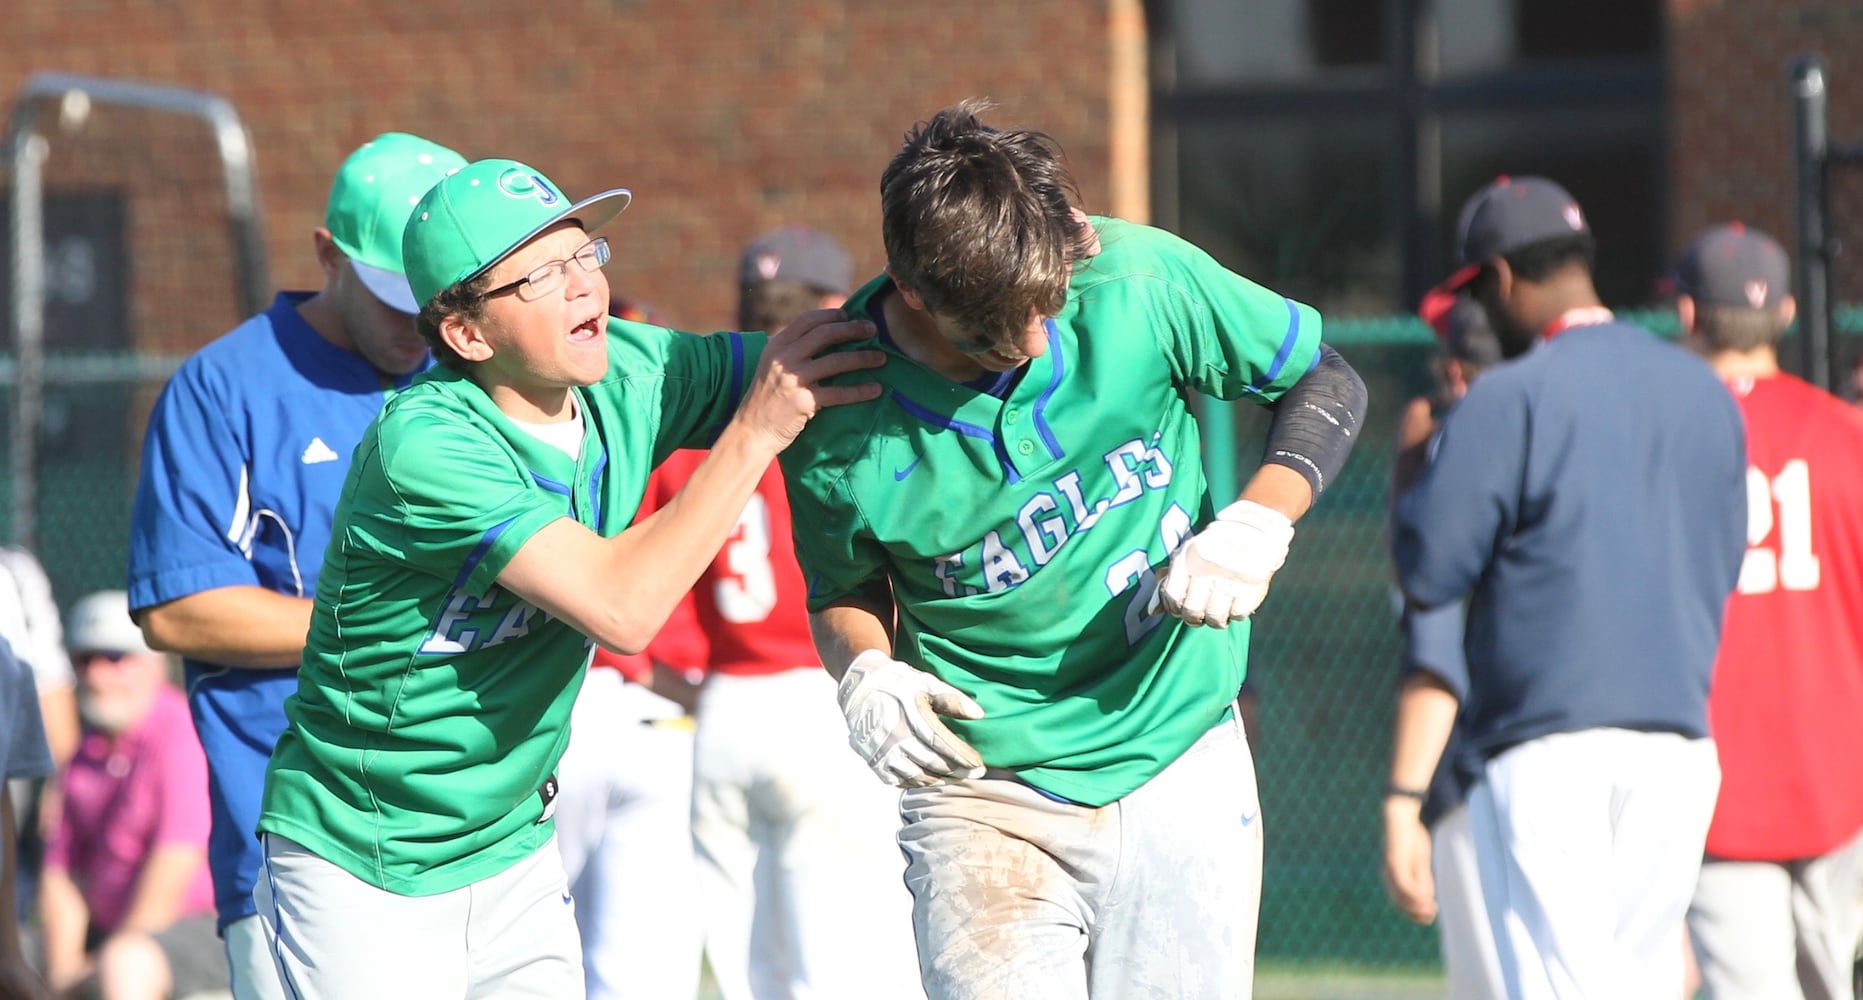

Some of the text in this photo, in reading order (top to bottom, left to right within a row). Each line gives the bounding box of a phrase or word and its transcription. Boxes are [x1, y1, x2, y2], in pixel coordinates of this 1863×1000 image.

[932, 431, 1173, 598] EAGLES
[1737, 458, 1821, 595] 21
[545, 781, 556, 797] S
